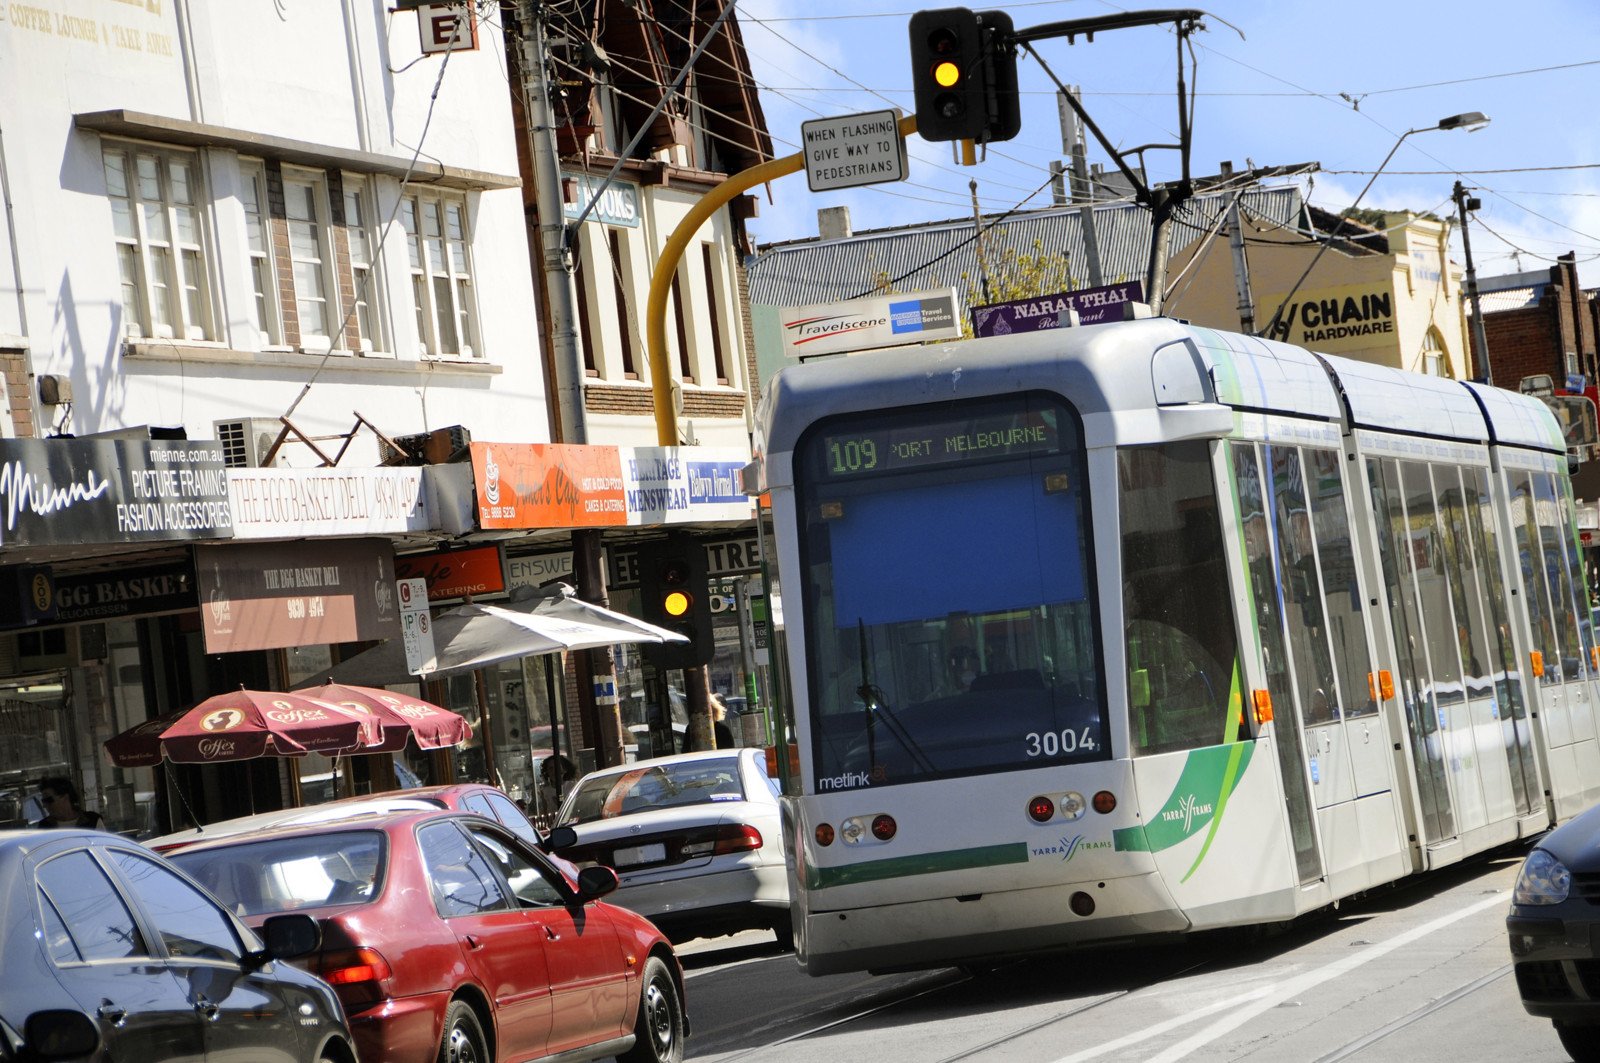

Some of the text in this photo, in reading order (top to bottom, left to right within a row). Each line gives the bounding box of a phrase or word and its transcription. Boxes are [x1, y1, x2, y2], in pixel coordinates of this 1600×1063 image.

[9, 3, 52, 34] COFFEE
[55, 12, 98, 44] LOUNGE
[112, 24, 142, 51] TAKE
[146, 31, 173, 57] AWAY
[806, 120, 893, 142] WHEN FLASHING
[814, 141, 890, 162] GIVE WAY TO
[816, 160, 892, 180] PEDESTRIANS
[921, 308, 942, 316] Travel
[1014, 288, 1129, 320] NARAI THAI
[1302, 292, 1392, 328] CHAIN
[797, 316, 887, 336] Travelscene
[922, 314, 952, 323] Services
[1303, 321, 1393, 342] HARDWARE
[150, 446, 223, 462] mienne.com.au
[830, 426, 1047, 472] 109 ORT MELBOURNE
[628, 458, 682, 482] HERITAGE
[132, 470, 226, 498] PICTURE FRAMING
[582, 478, 592, 490] HOT
[0, 460, 109, 531] Mienne
[232, 478, 260, 524] THE
[260, 478, 290, 524] EGG
[290, 478, 338, 522] BASKET
[338, 477, 368, 520] DELI
[584, 500, 599, 512] CAKES
[604, 500, 624, 512] CATERING
[628, 488, 688, 512] MENSWEAR
[116, 501, 232, 532] FASHION ACCESSORIES
[706, 540, 760, 573] TRE
[264, 566, 340, 589] THE EGG BASKET DELI
[36, 577, 47, 608] 308
[56, 574, 190, 608] GG BASKET
[427, 584, 487, 598] ATERING
[288, 598, 305, 619] 9830
[198, 738, 236, 760] Coffex
[1026, 726, 1096, 757] 3004
[820, 771, 870, 790] metlink
[1162, 804, 1212, 821] YARRA TRAMS
[1032, 842, 1112, 856] YARRA TRAMS
